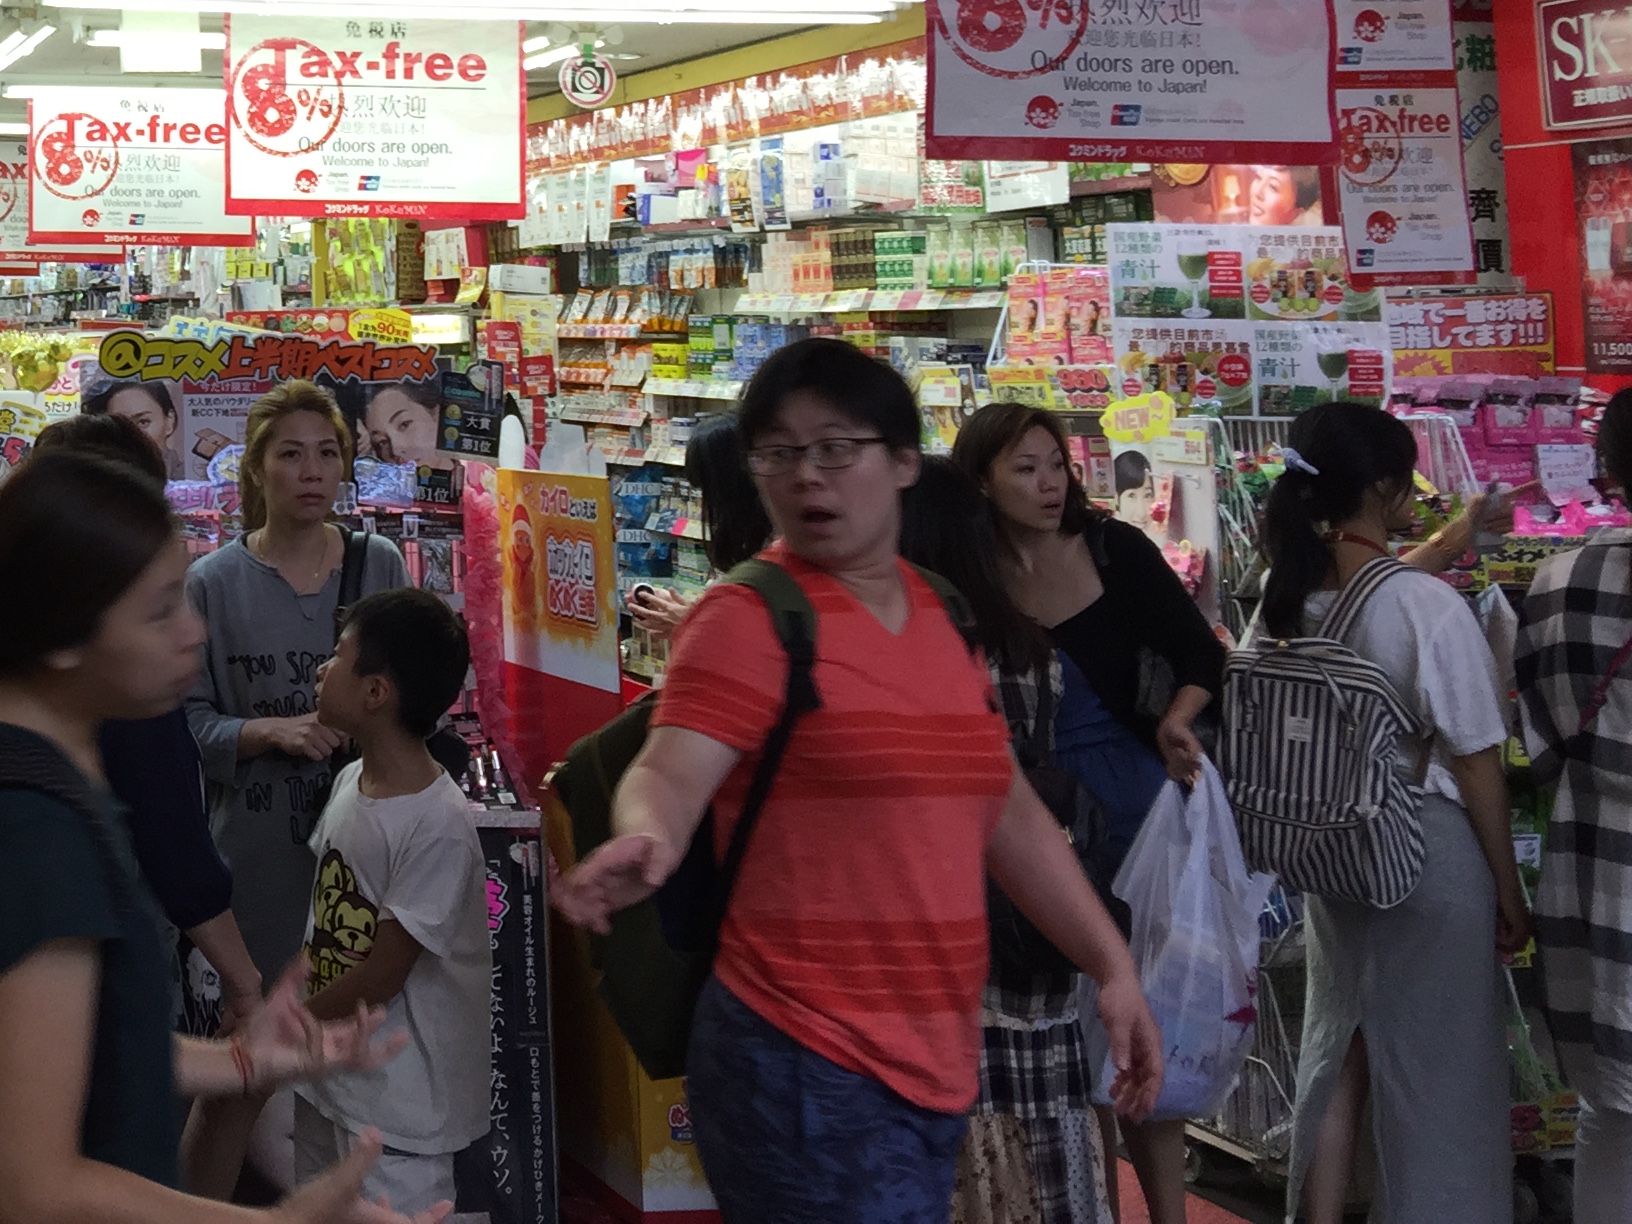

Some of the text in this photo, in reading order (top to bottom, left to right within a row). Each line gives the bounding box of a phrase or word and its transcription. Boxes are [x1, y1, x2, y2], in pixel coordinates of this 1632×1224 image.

[262, 39, 487, 82] Tax-free
[1076, 52, 1134, 75] doors
[1141, 57, 1175, 75] are
[1182, 57, 1240, 78] open.
[1064, 77, 1207, 95] Welcome to Japan!
[57, 113, 225, 144] Tax-free
[332, 137, 375, 153] doors
[381, 142, 407, 154] are
[412, 141, 452, 156] open.
[322, 154, 429, 169] Welcome to Japan!
[110, 185, 142, 198] doors
[146, 188, 164, 198] are
[167, 187, 201, 200] open.
[1118, 259, 1161, 279] 青汁
[1258, 358, 1301, 379] 青汁
[625, 482, 654, 495] DHC
